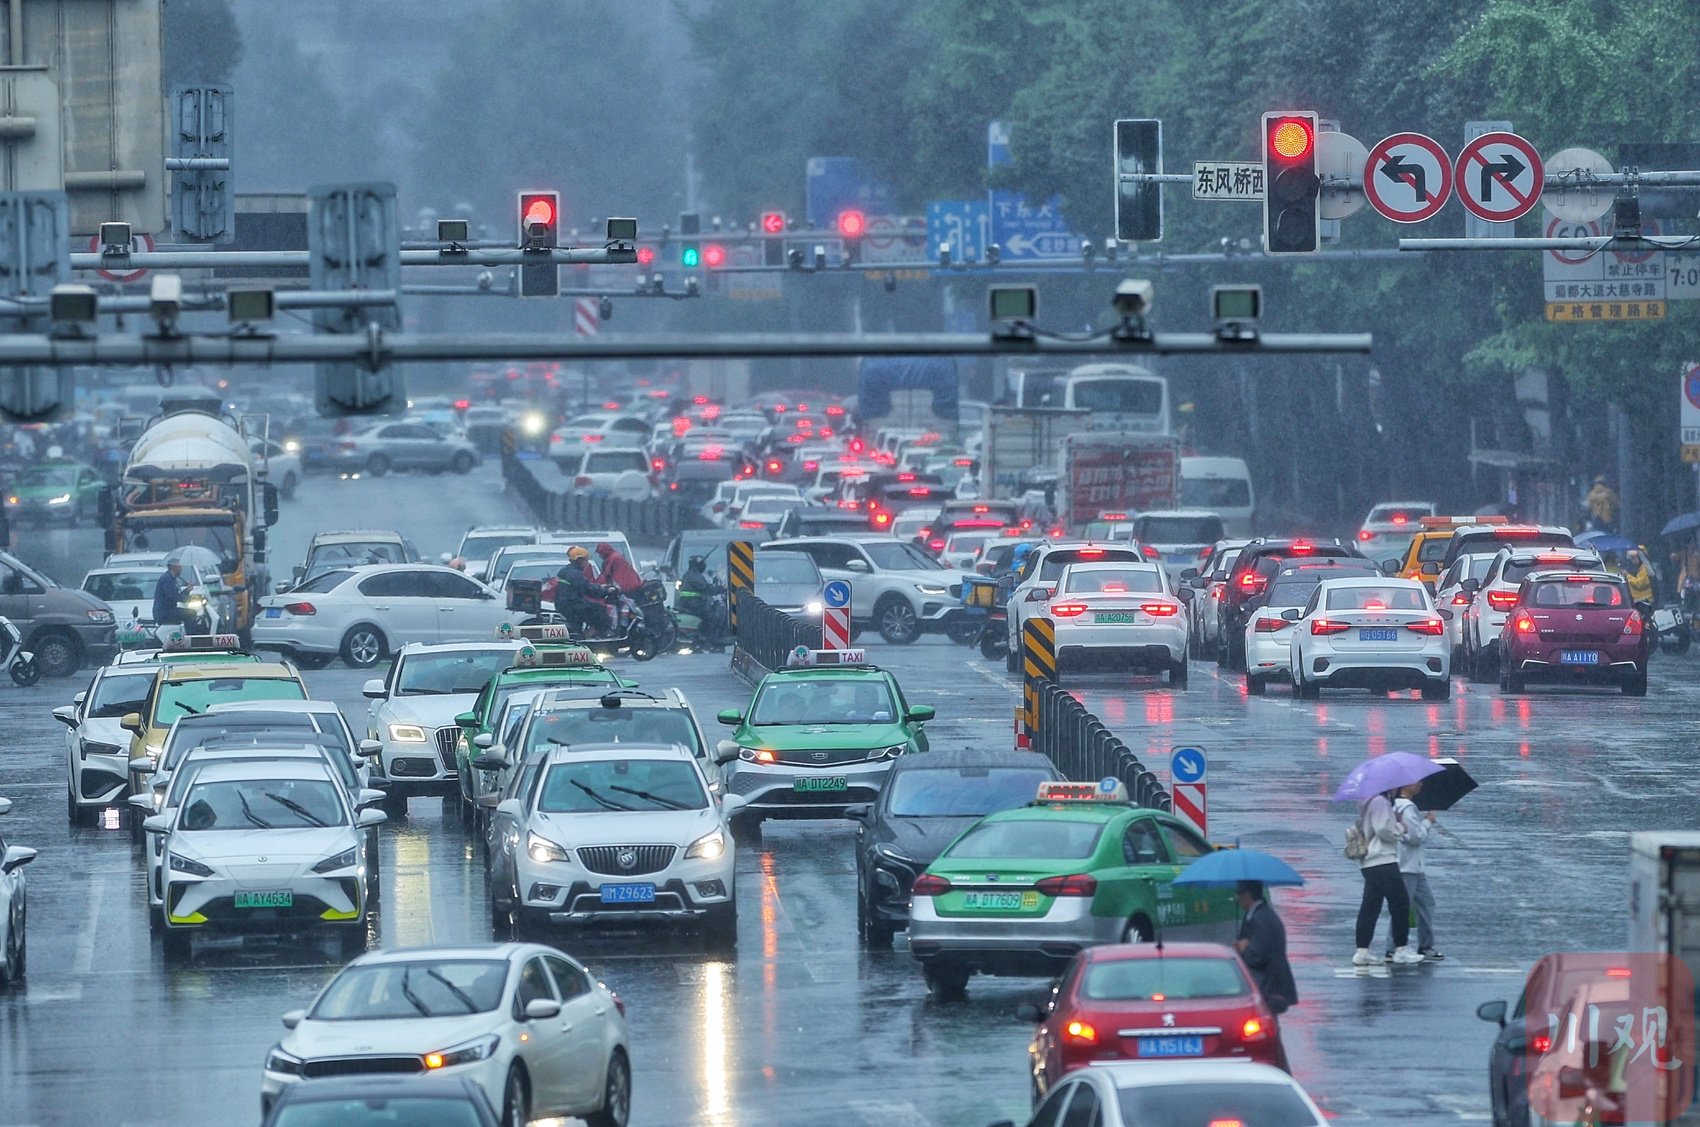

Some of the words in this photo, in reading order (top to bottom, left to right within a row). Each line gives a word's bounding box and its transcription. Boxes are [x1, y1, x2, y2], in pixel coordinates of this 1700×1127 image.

[1197, 166, 1263, 195] 东风桥西
[1608, 263, 1661, 277] 禁止停车
[1670, 268, 1700, 287] 7:0
[1555, 284, 1656, 299] 蜀都大道大慈寺路
[1552, 303, 1660, 319] 严格管理路段
[544, 628, 565, 638] TAXI
[215, 636, 236, 647] TAXI
[568, 653, 589, 663] TAXI
[842, 652, 863, 663] TAXI
